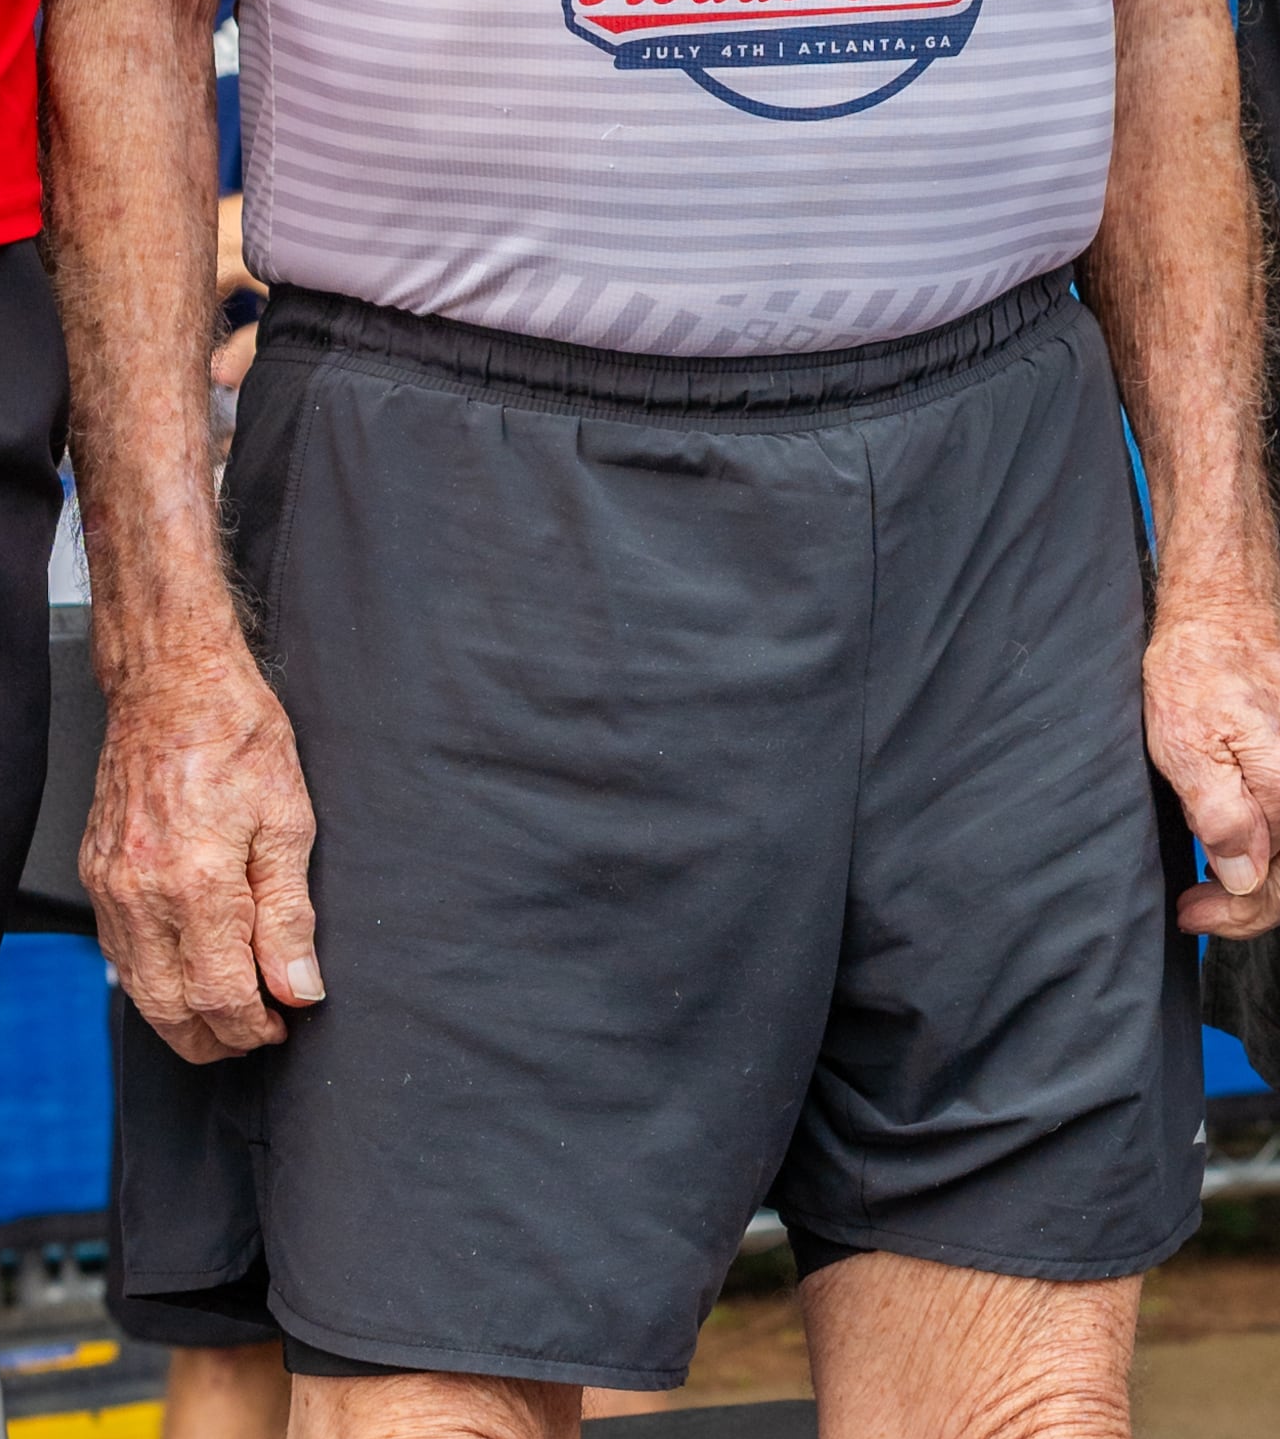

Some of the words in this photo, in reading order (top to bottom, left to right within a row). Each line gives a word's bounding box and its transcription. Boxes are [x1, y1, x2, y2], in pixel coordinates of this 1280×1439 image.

[642, 45, 701, 61] JULY
[721, 43, 767, 58] 4TH
[798, 37, 916, 55] ATLANTA,
[925, 34, 951, 49] GA
